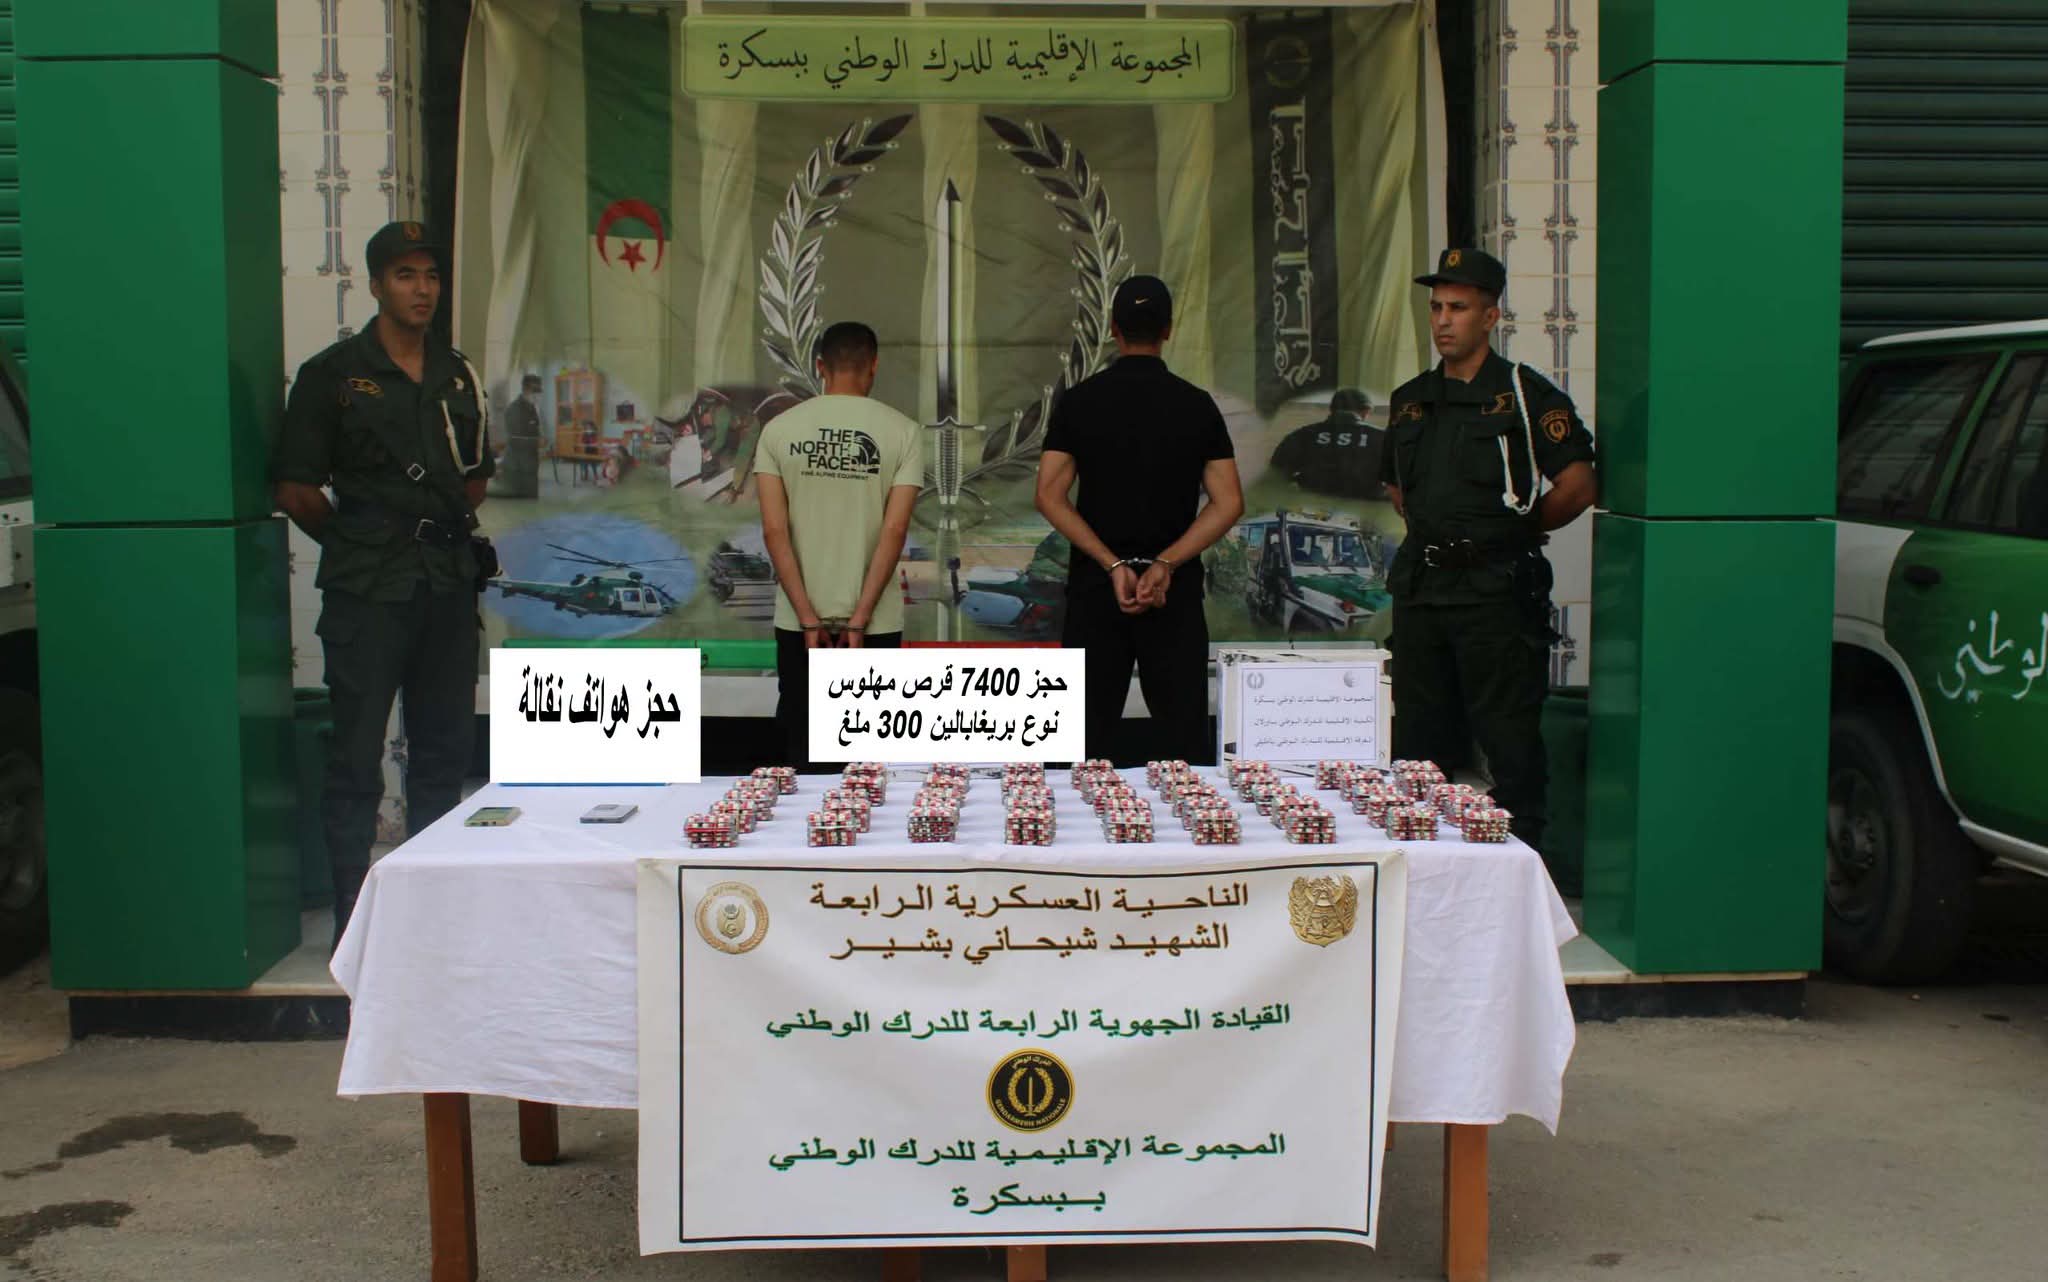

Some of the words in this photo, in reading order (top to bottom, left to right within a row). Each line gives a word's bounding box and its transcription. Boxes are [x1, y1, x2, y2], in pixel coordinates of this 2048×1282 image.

[717, 28, 809, 80] ببسكرة
[823, 36, 909, 91] الوطني
[922, 38, 993, 83] للدرك
[1006, 28, 1097, 83] الإقليمية
[1111, 37, 1201, 84] المجموعة
[790, 441, 851, 457] NORTH
[818, 427, 853, 443] THE
[807, 454, 850, 471] FACE
[809, 882, 934, 912] الرابعة
[945, 884, 1101, 915] العسكرية
[1111, 883, 1249, 913] الناحية
[829, 927, 954, 961] بشير
[963, 926, 1098, 966] شيحاني
[1109, 922, 1229, 958] الشهيد
[765, 1009, 870, 1039] الوطني
[881, 1010, 970, 1040] للدرك
[978, 1009, 1078, 1039] الرابعة
[1088, 1008, 1201, 1038] الجهوية
[1211, 1003, 1291, 1032] القيادة
[768, 1137, 876, 1172] الوطني
[887, 1138, 977, 1167] للدرك
[984, 1137, 1132, 1167] الإقليمية
[1141, 1132, 1286, 1163] المجموعة
[950, 1183, 1107, 1216] ببسكرة
